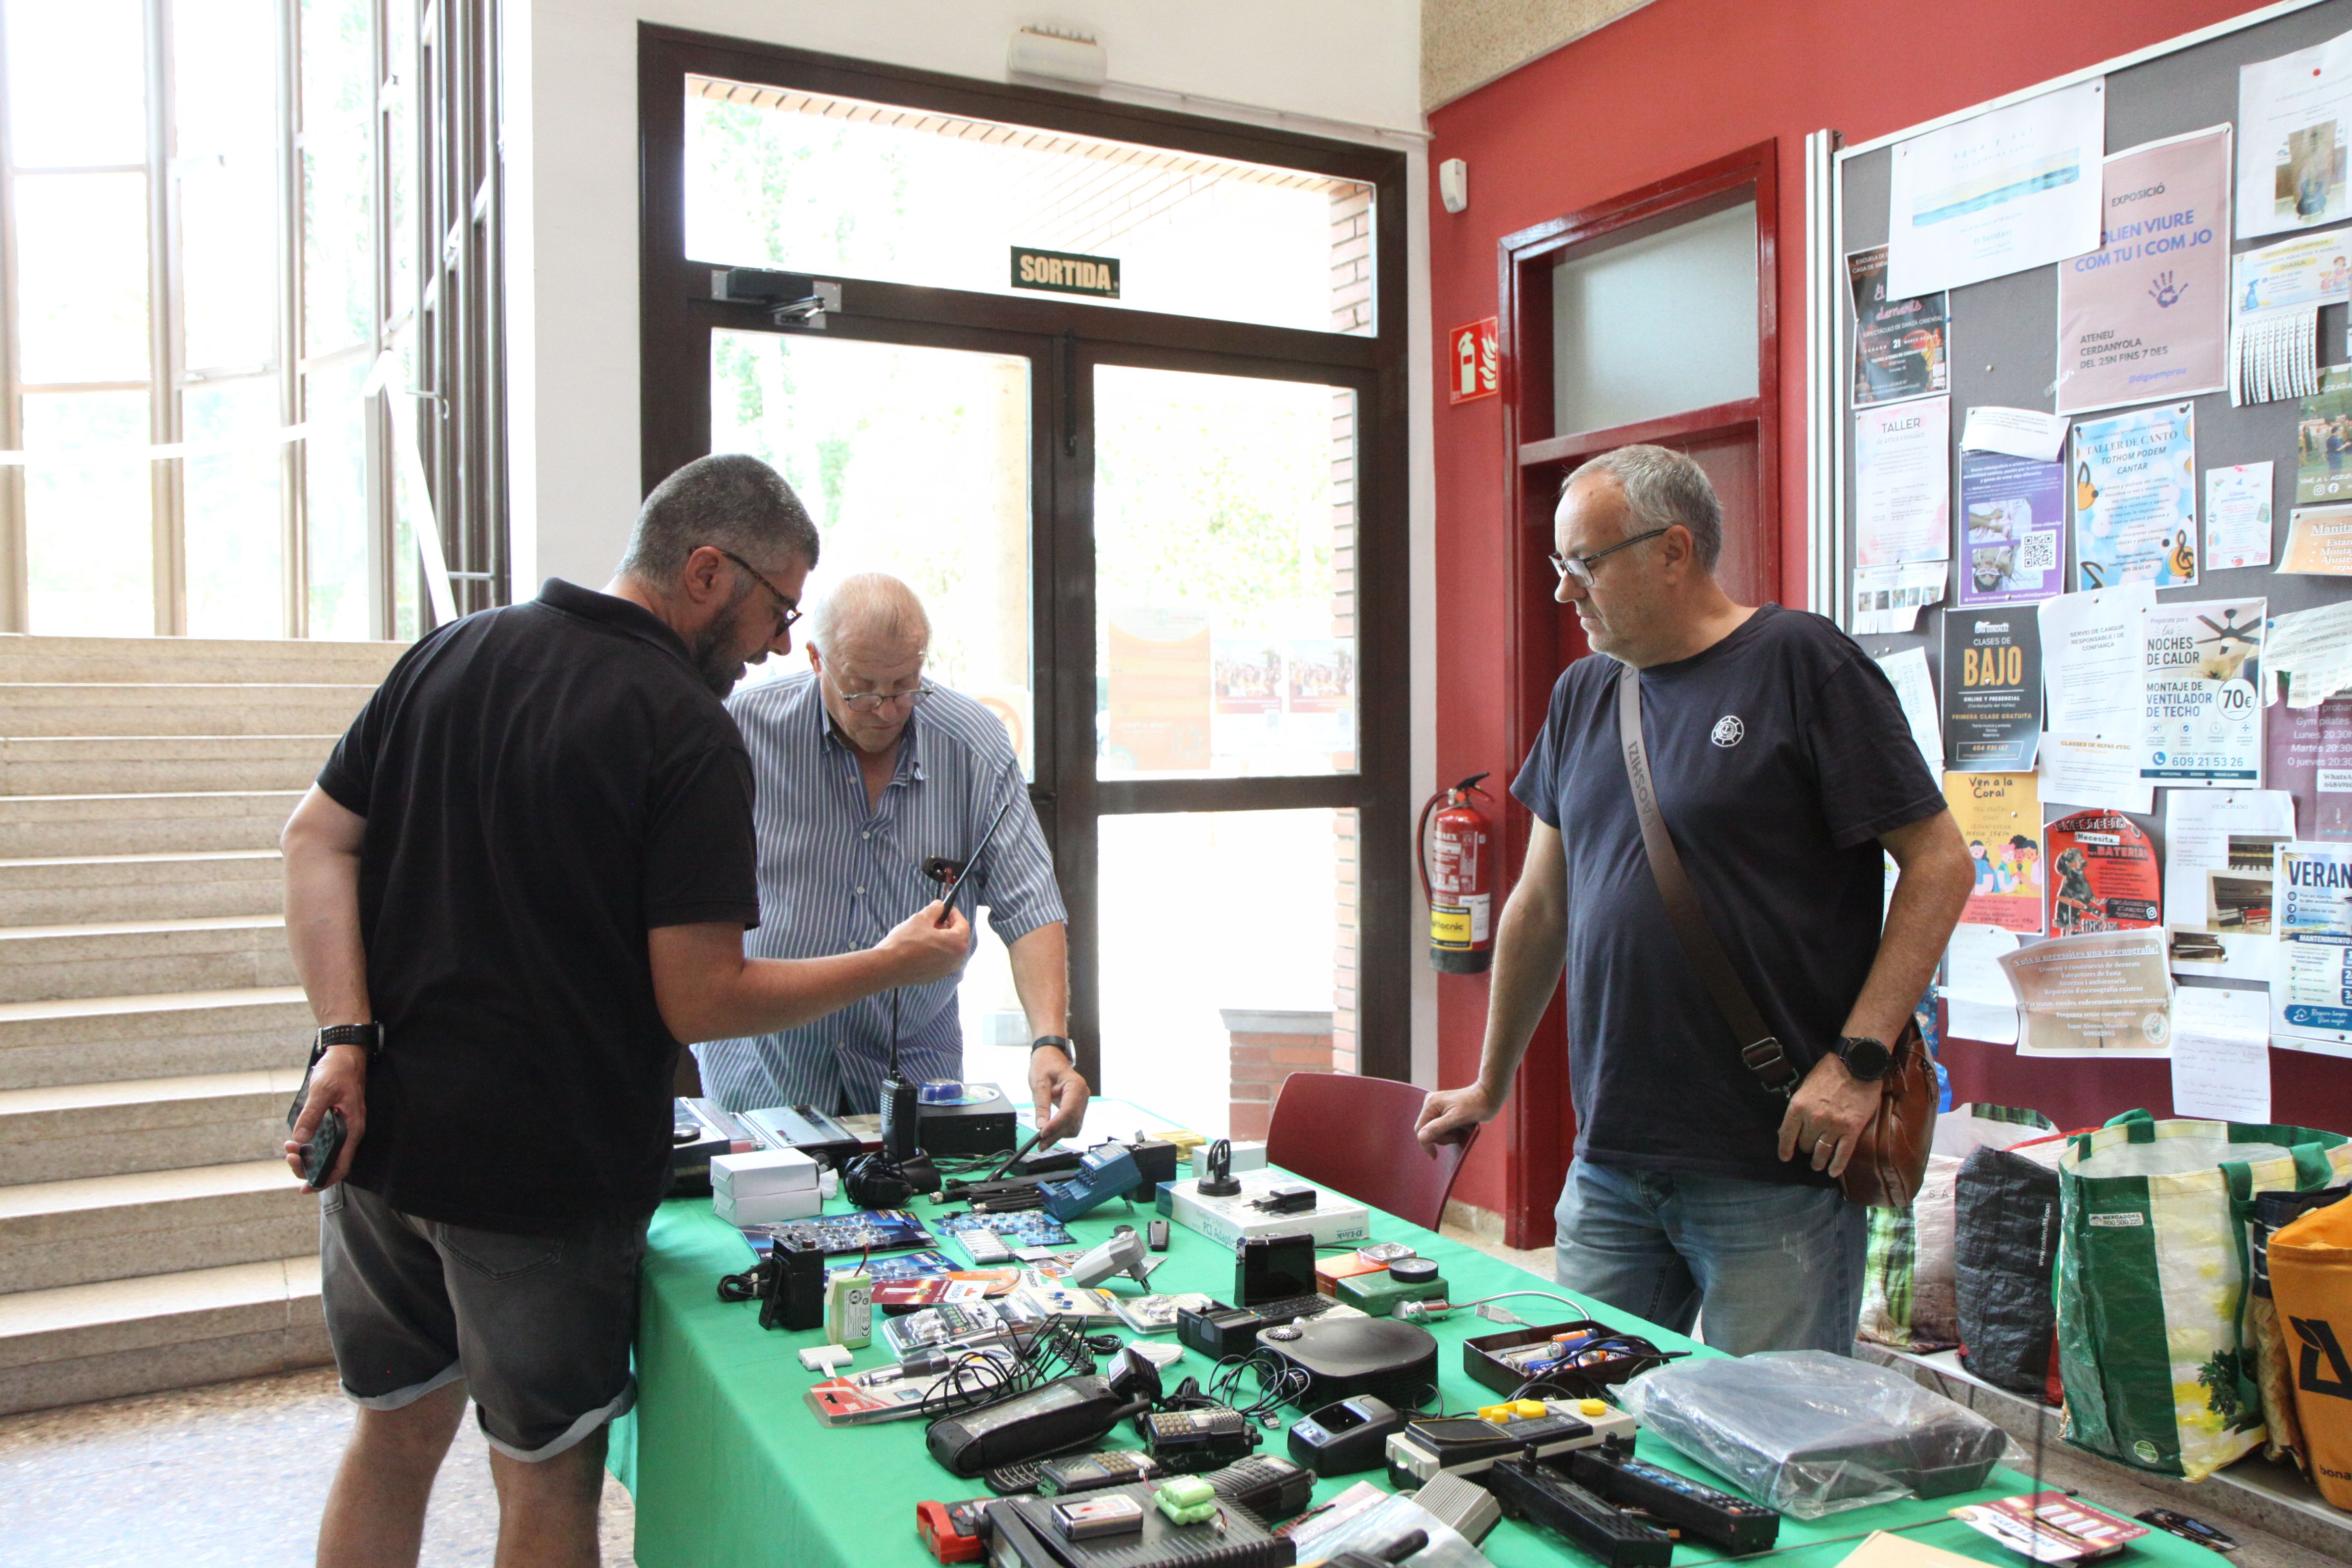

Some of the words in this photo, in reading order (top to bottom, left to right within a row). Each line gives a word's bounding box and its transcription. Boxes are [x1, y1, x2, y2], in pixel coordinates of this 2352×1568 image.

[2112, 182, 2165, 206] EXPOSICIÓ
[2101, 222, 2141, 245] OLIEN
[2145, 210, 2194, 233] VIURE
[2075, 252, 2111, 272] COM
[2113, 246, 2132, 263] TU
[2137, 245, 2141, 258] I
[2145, 235, 2185, 255] COM
[2189, 229, 2212, 246] JO
[1020, 254, 1111, 290] SORTIDA
[2081, 330, 2114, 343] ATENEU
[1893, 339, 1901, 348] 21
[2081, 338, 2142, 356] CERDANYOLA
[2080, 359, 2095, 369] DEL
[2099, 355, 2116, 366] 25N
[2119, 351, 2139, 362] FINS
[2142, 349, 2148, 358] 7
[2150, 346, 2168, 356] DES
[1882, 418, 1920, 433] TALLER
[2086, 441, 2124, 455] TALLER
[2126, 438, 2138, 446] DE
[2141, 431, 2177, 444] CANTO
[2102, 451, 2135, 465] TOTHOM
[2137, 446, 2166, 459] PODEM
[2117, 463, 2148, 474] CANTAR
[2101, 625, 2124, 633] CANGUR
[2162, 625, 2174, 636] las
[2071, 635, 2112, 645] RESPONSABLE
[2082, 642, 2114, 651] CONFIANÇA
[2148, 637, 2193, 651] NOCHES
[2147, 653, 2159, 665] DE
[2163, 651, 2200, 665] CALOR
[1964, 646, 2021, 686] BAJO
[2147, 682, 2189, 692] MONTAJE
[2191, 682, 2203, 690] DE
[2147, 693, 2212, 704] VENTILADOR
[2222, 689, 2252, 709] 70€
[2147, 707, 2159, 717] DE
[2163, 706, 2200, 717] TECHO
[2297, 718, 2316, 728] Gym
[2320, 717, 2350, 726] pilates
[2172, 757, 2194, 766] 609
[2198, 757, 2208, 766] 21
[2214, 757, 2227, 766] 53
[2231, 757, 2243, 767] 26
[2297, 758, 2325, 767] jueves
[1969, 777, 1990, 786] Ven
[2004, 778, 2012, 786] la
[1974, 787, 2004, 798] Coral
[2300, 934, 2350, 944] MANTENIMIENTO
[2013, 957, 2033, 966] Vols
[2043, 950, 2084, 961] necessites
[1203, 1222, 1213, 1235] PCI
[1337, 1229, 1363, 1239] D-Link
[2038, 1203, 2051, 1266] www.cadena88.com
[949, 1284, 965, 1299] PHILIPS
